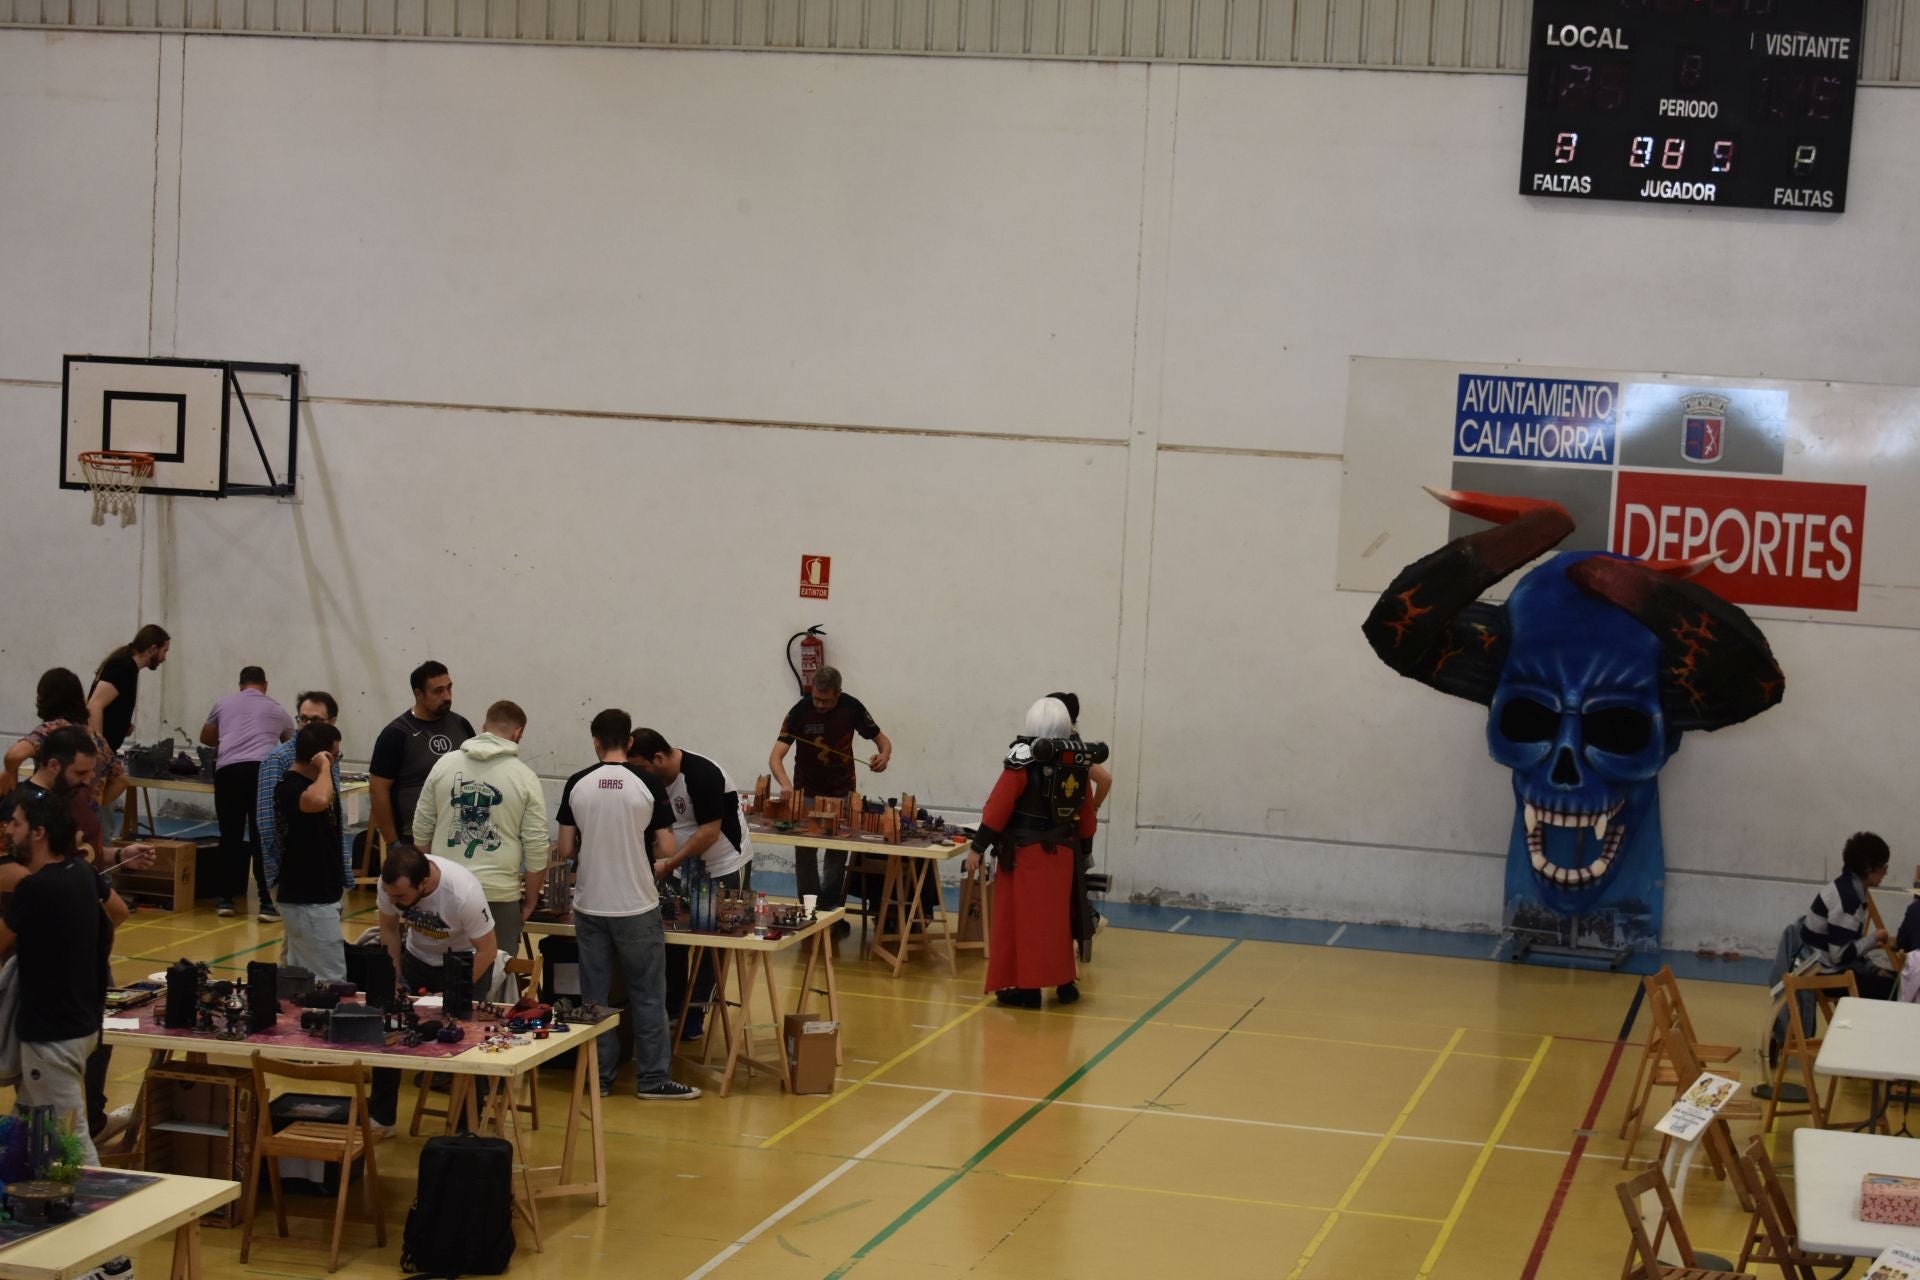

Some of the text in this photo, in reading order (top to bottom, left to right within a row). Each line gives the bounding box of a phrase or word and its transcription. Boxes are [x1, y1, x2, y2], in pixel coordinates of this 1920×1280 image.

[1547, 24, 1629, 50] LOCAL
[1766, 33, 1850, 60] VISITANTE
[1659, 98, 1719, 119] PERIODO
[1533, 173, 1592, 194] FALTAS
[1640, 180, 1716, 201] JUGADOR
[1773, 187, 1834, 209] FALTAS
[1462, 378, 1613, 420] AYUNTAMIENTO
[1459, 418, 1608, 462] CALAHORRA
[1622, 503, 1854, 582] DEPORTES
[801, 587, 828, 598] EXTINTOR
[433, 738, 448, 752] 90
